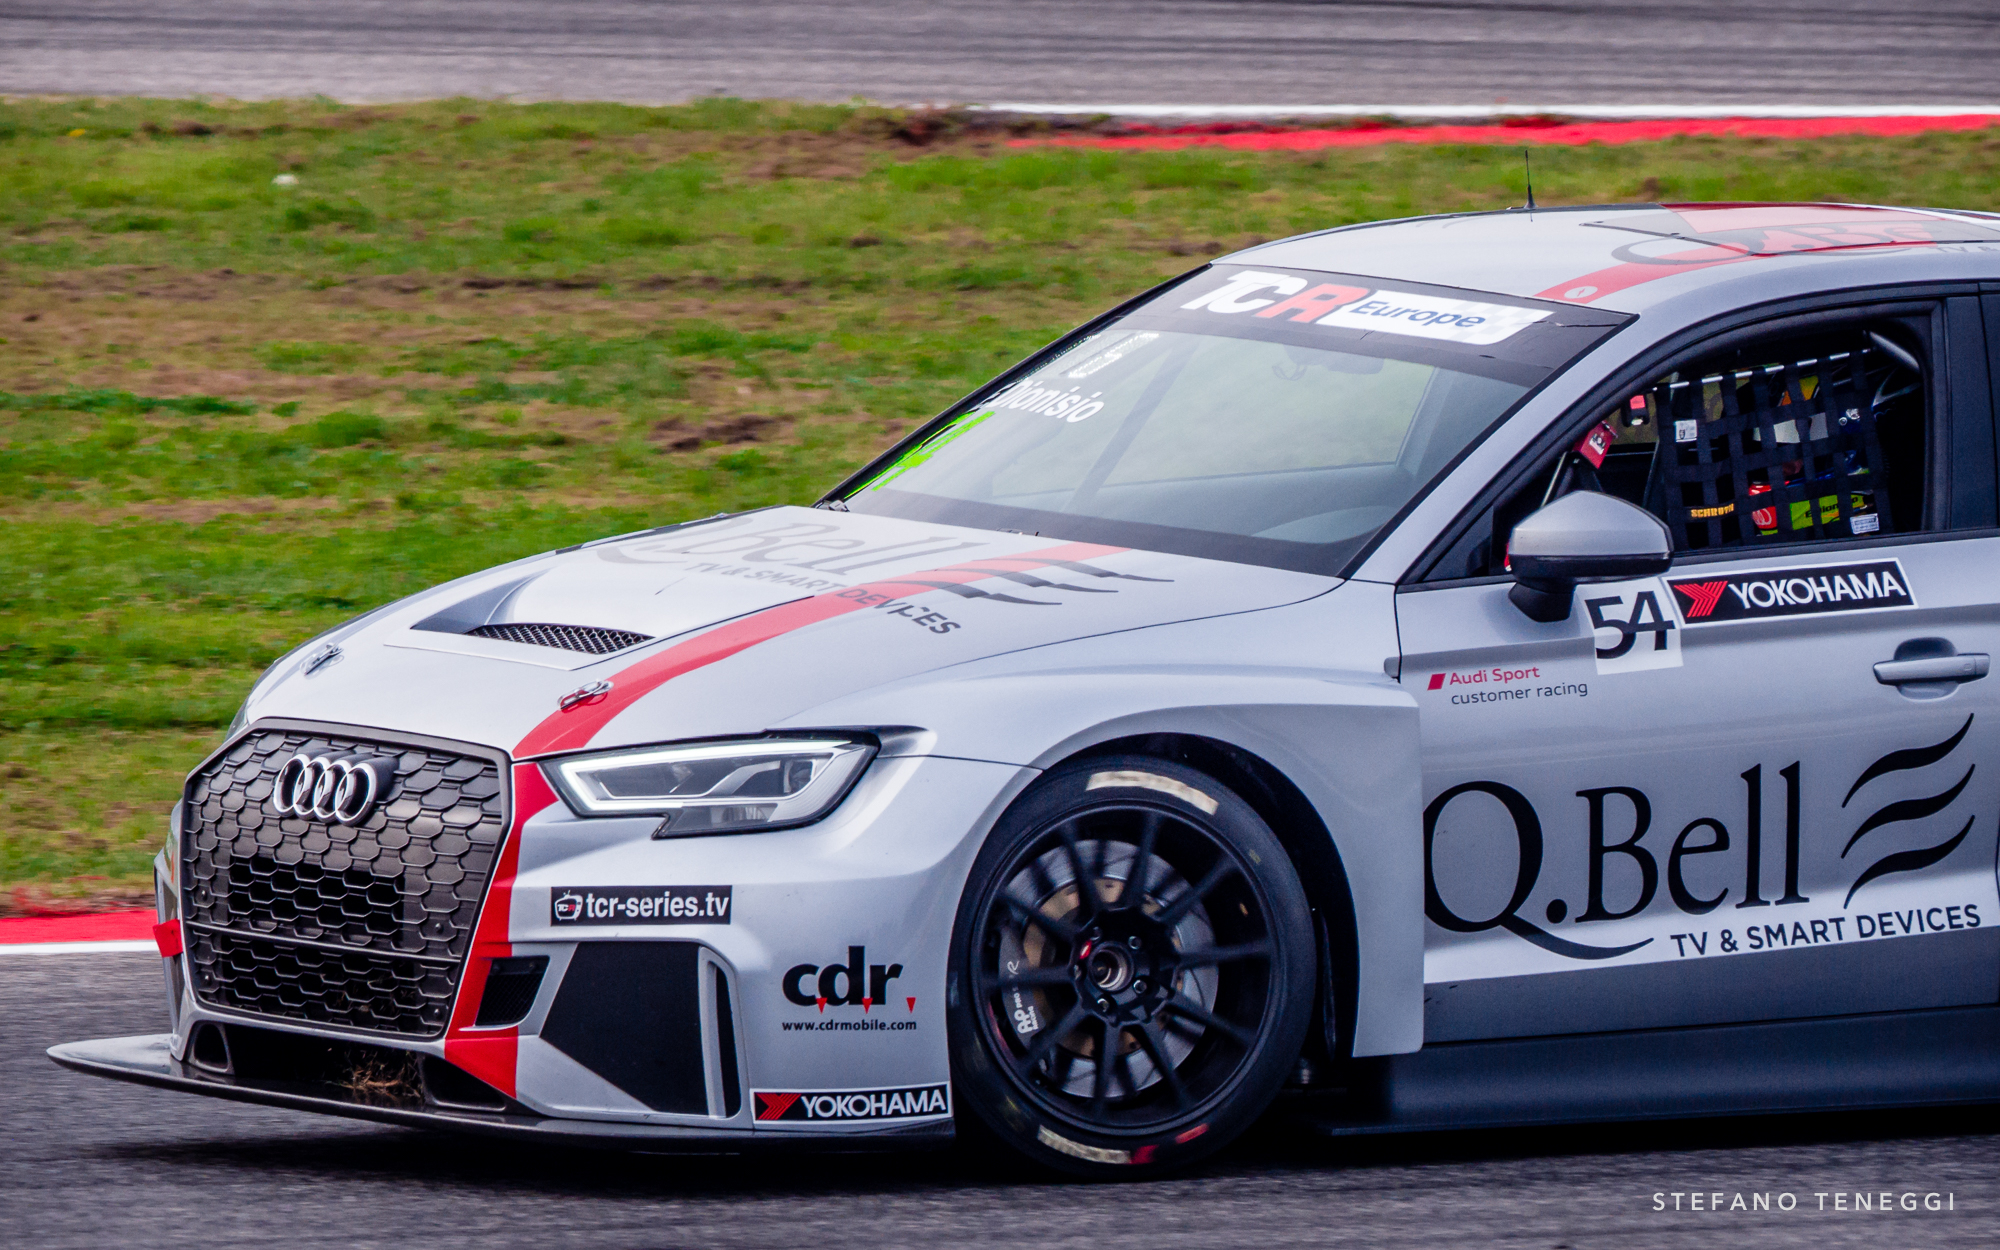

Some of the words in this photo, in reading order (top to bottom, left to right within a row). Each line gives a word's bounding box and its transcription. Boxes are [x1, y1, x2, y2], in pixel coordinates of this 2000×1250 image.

[1180, 270, 1370, 322] TCR
[1349, 301, 1486, 328] Europe
[686, 562, 726, 576] TV
[721, 566, 751, 576] &
[744, 568, 849, 591] SMART
[836, 588, 961, 634] DEVICES
[1728, 571, 1907, 609] YOKOHAMA
[1584, 590, 1676, 659] 54
[1449, 669, 1488, 685] Audi
[1492, 667, 1540, 684] Sport
[1451, 688, 1531, 705] customer
[1537, 682, 1588, 697] racing
[1423, 761, 1809, 960] Q.Bell
[586, 890, 729, 918] tcr-series.tv
[1670, 931, 1708, 957] TV
[1720, 929, 1739, 952] &
[1747, 917, 1846, 950] SMART
[1856, 904, 1981, 938] DEVICES
[782, 1019, 917, 1031] www.cdrmobile.com
[801, 1089, 946, 1118] YOKOHAMA
